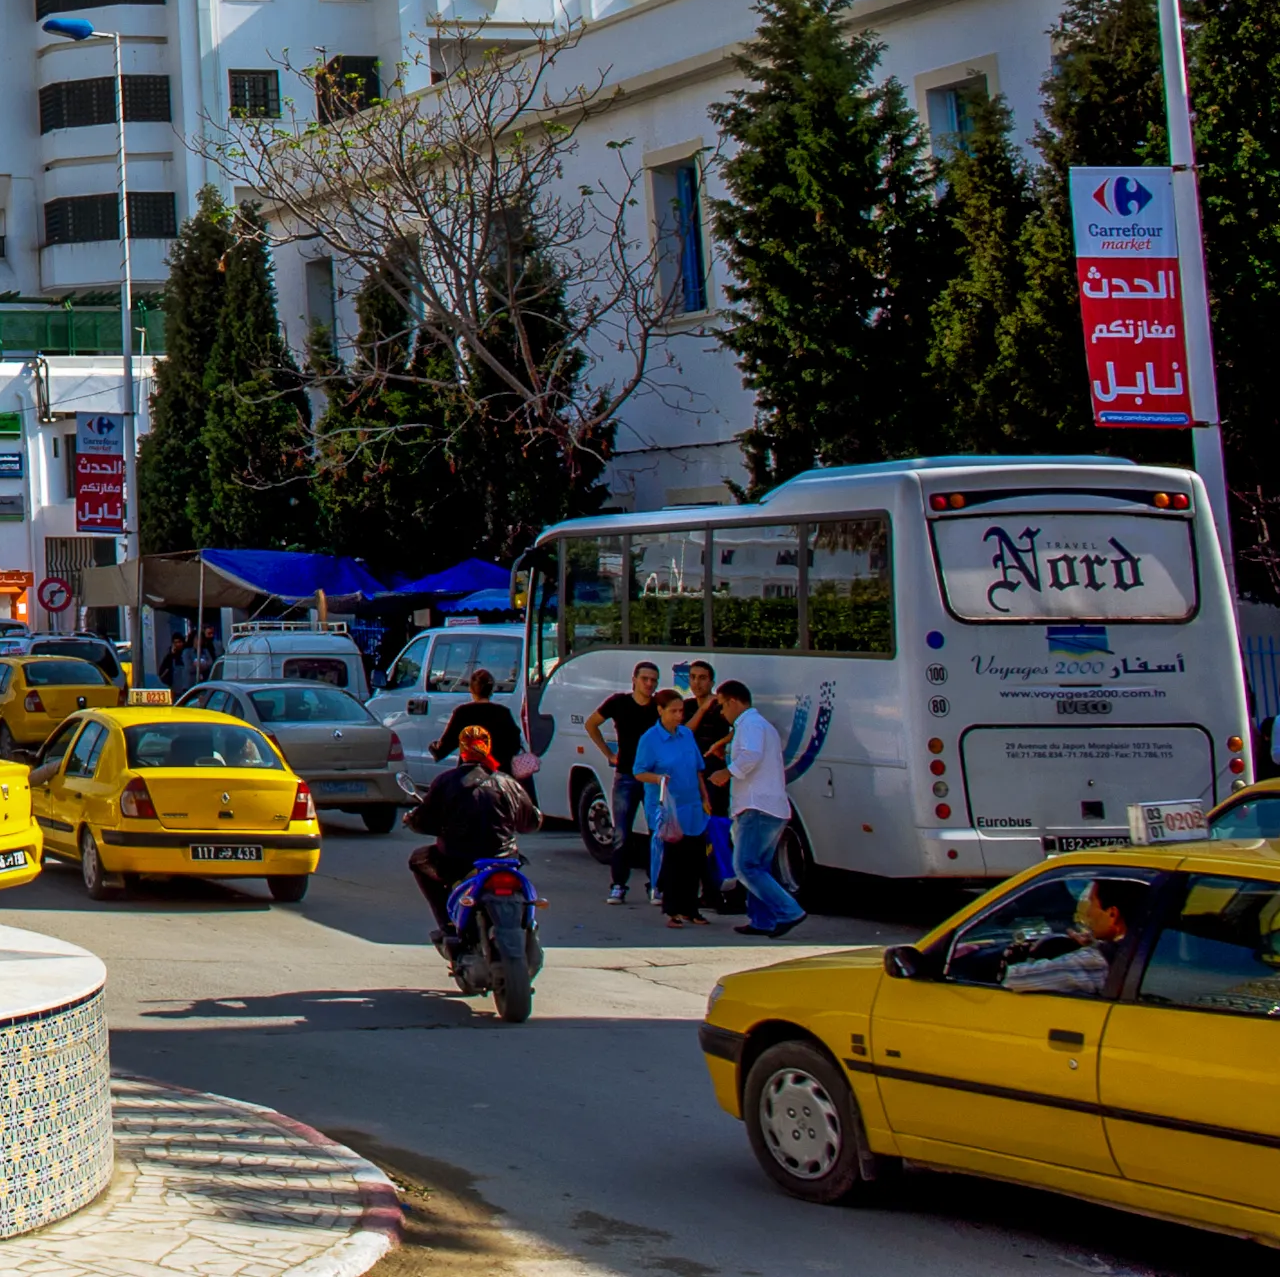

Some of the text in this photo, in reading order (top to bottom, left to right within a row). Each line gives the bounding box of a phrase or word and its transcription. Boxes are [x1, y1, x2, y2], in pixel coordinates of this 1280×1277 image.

[1088, 223, 1163, 237] Carrefour
[1101, 238, 1152, 251] market
[1082, 266, 1175, 299] الحدث
[1091, 320, 1176, 344] مغازتكم
[1093, 361, 1184, 405] نابل
[78, 458, 122, 474] الحدث
[78, 502, 122, 523] نابل
[1046, 542, 1098, 550] TRAVEL
[983, 526, 1145, 612] Nord
[971, 655, 1106, 680] Voyages 2000
[1109, 653, 1186, 678] أسفار
[929, 666, 945, 681] 100
[1000, 689, 1167, 699] www.voyages2000.com.tn
[932, 699, 946, 713] 80
[1056, 700, 1113, 714] IVECO
[1017, 742, 1048, 750] Avenue
[1050, 742, 1060, 750] du
[1062, 742, 1086, 752] Japon
[1088, 742, 1130, 751] Monplaisir
[1152, 742, 1173, 750] Tunis
[1146, 807, 1162, 820] 03
[976, 816, 1032, 827] Eurobus
[1150, 825, 1165, 838] 01
[1062, 838, 1084, 851] 132
[198, 847, 215, 859] 117
[237, 847, 257, 860] 433
